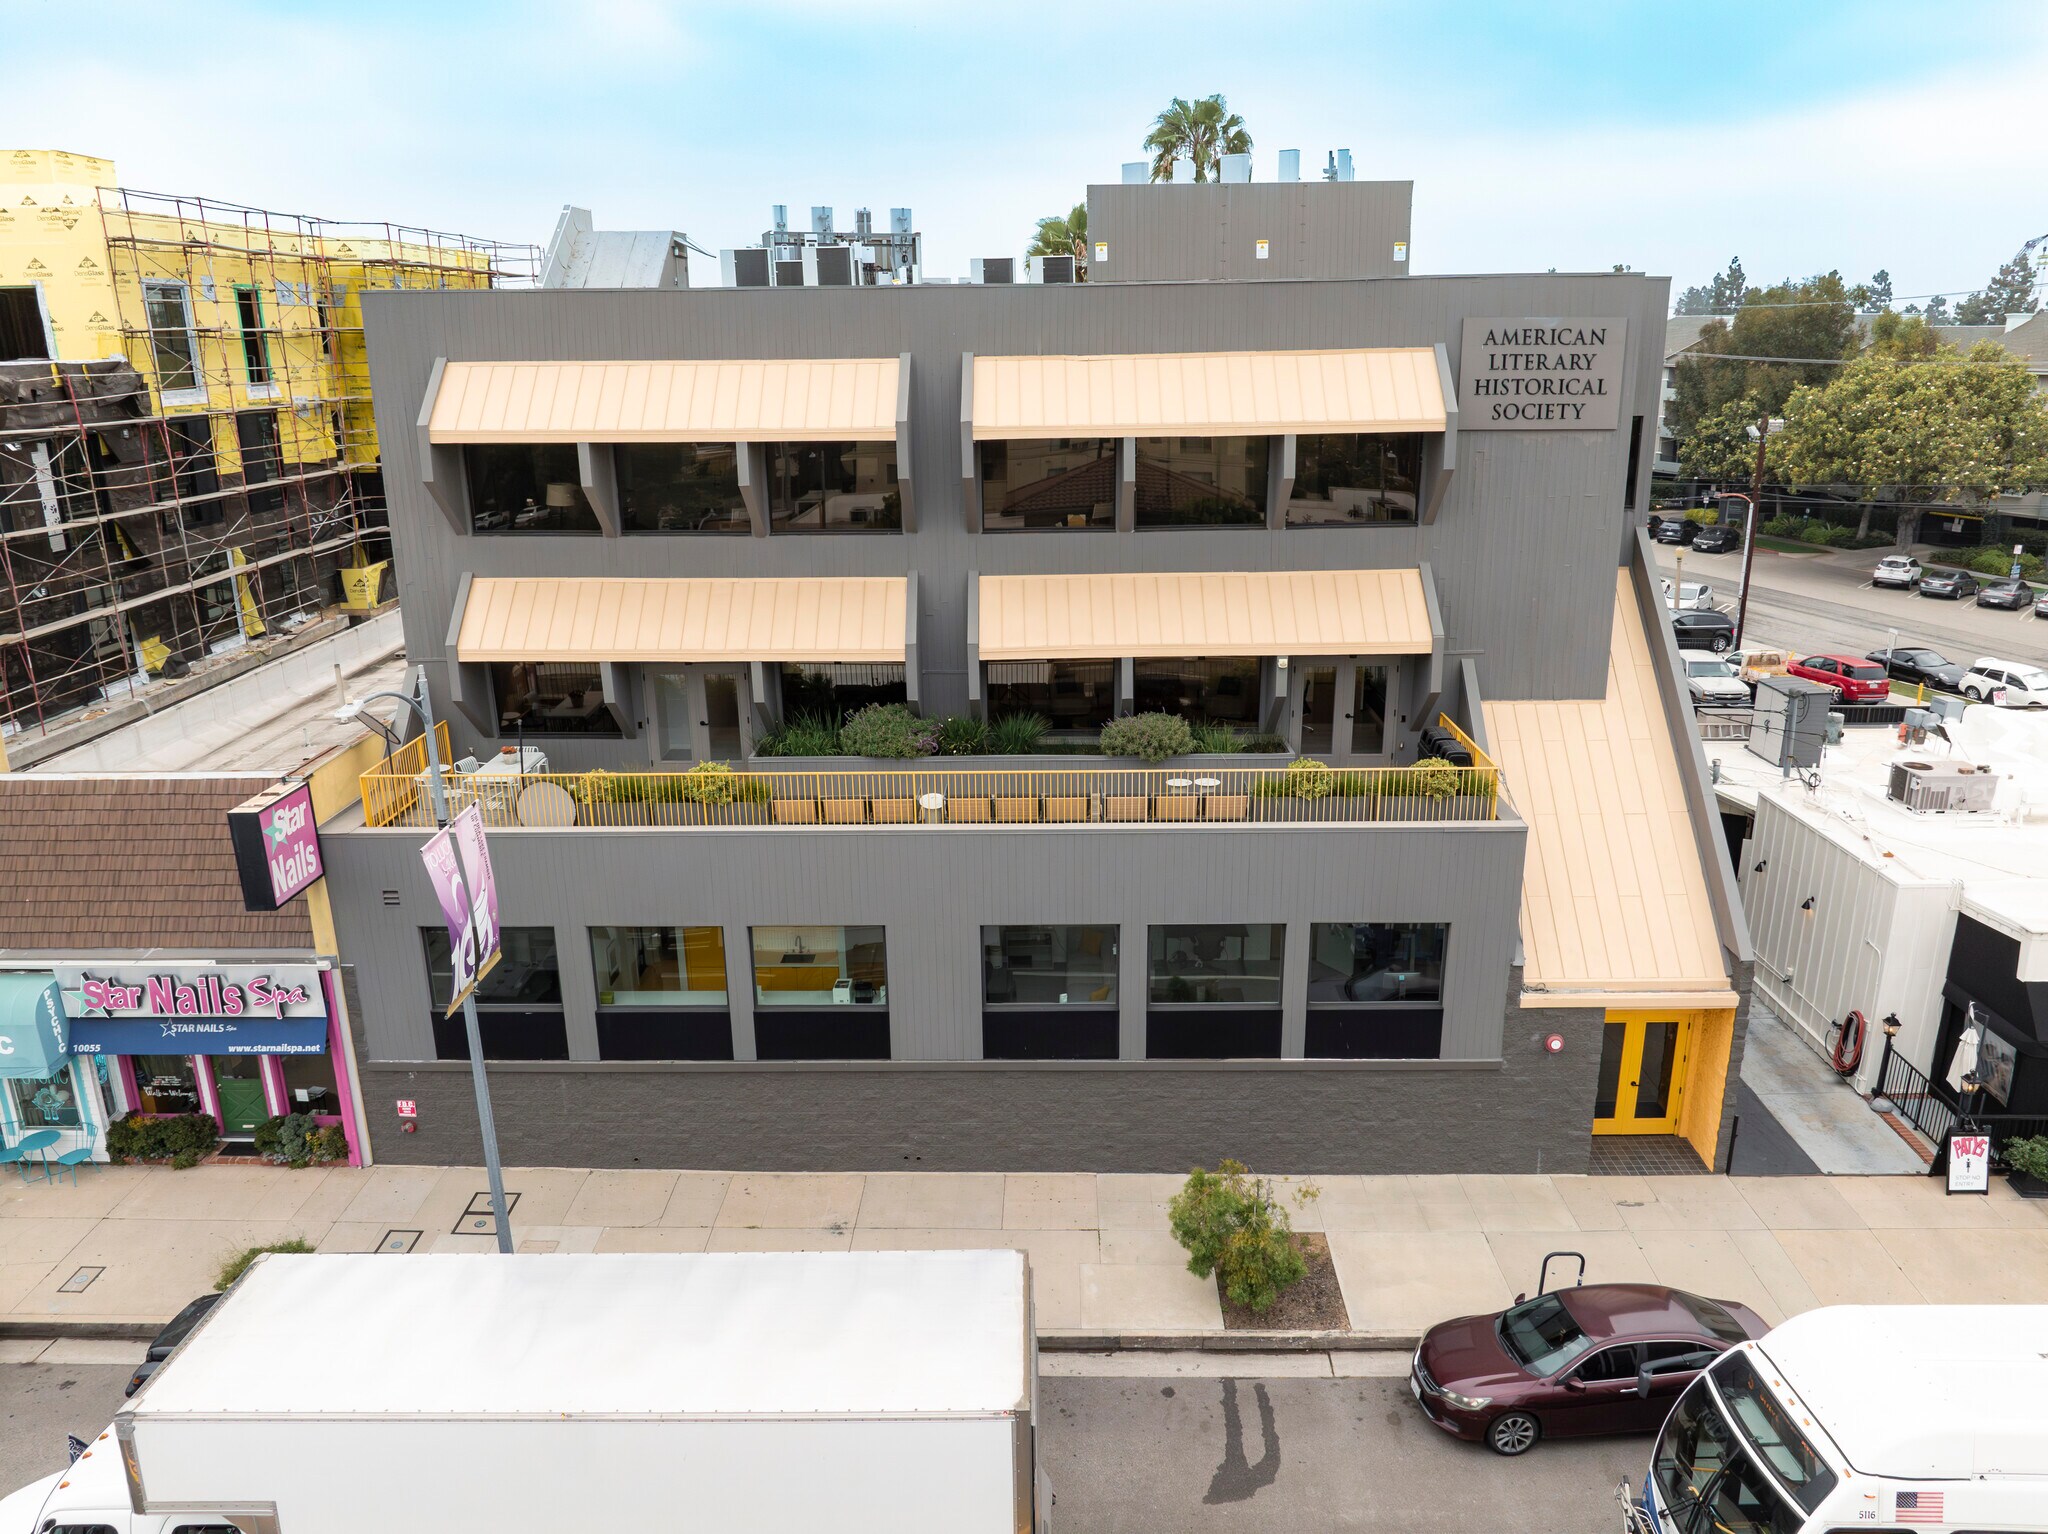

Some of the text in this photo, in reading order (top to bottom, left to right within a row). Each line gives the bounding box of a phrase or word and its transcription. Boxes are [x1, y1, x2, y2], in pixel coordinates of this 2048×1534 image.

[1483, 328, 1607, 346] AMERICAN
[1489, 353, 1598, 371] LITERARY
[1474, 378, 1608, 396] HISTORICAL
[1491, 403, 1586, 420] SOCIETY
[273, 801, 307, 842] Star
[271, 840, 317, 898] Nails
[82, 976, 309, 1019] Star Nails Spa
[43, 989, 67, 1053] PSYCHIC
[171, 1023, 195, 1033] STAR
[197, 1023, 225, 1033] NAILS
[73, 1044, 101, 1053] 10055
[228, 1043, 321, 1054] www.starnailspa.net
[1859, 1510, 1876, 1519] 5116
